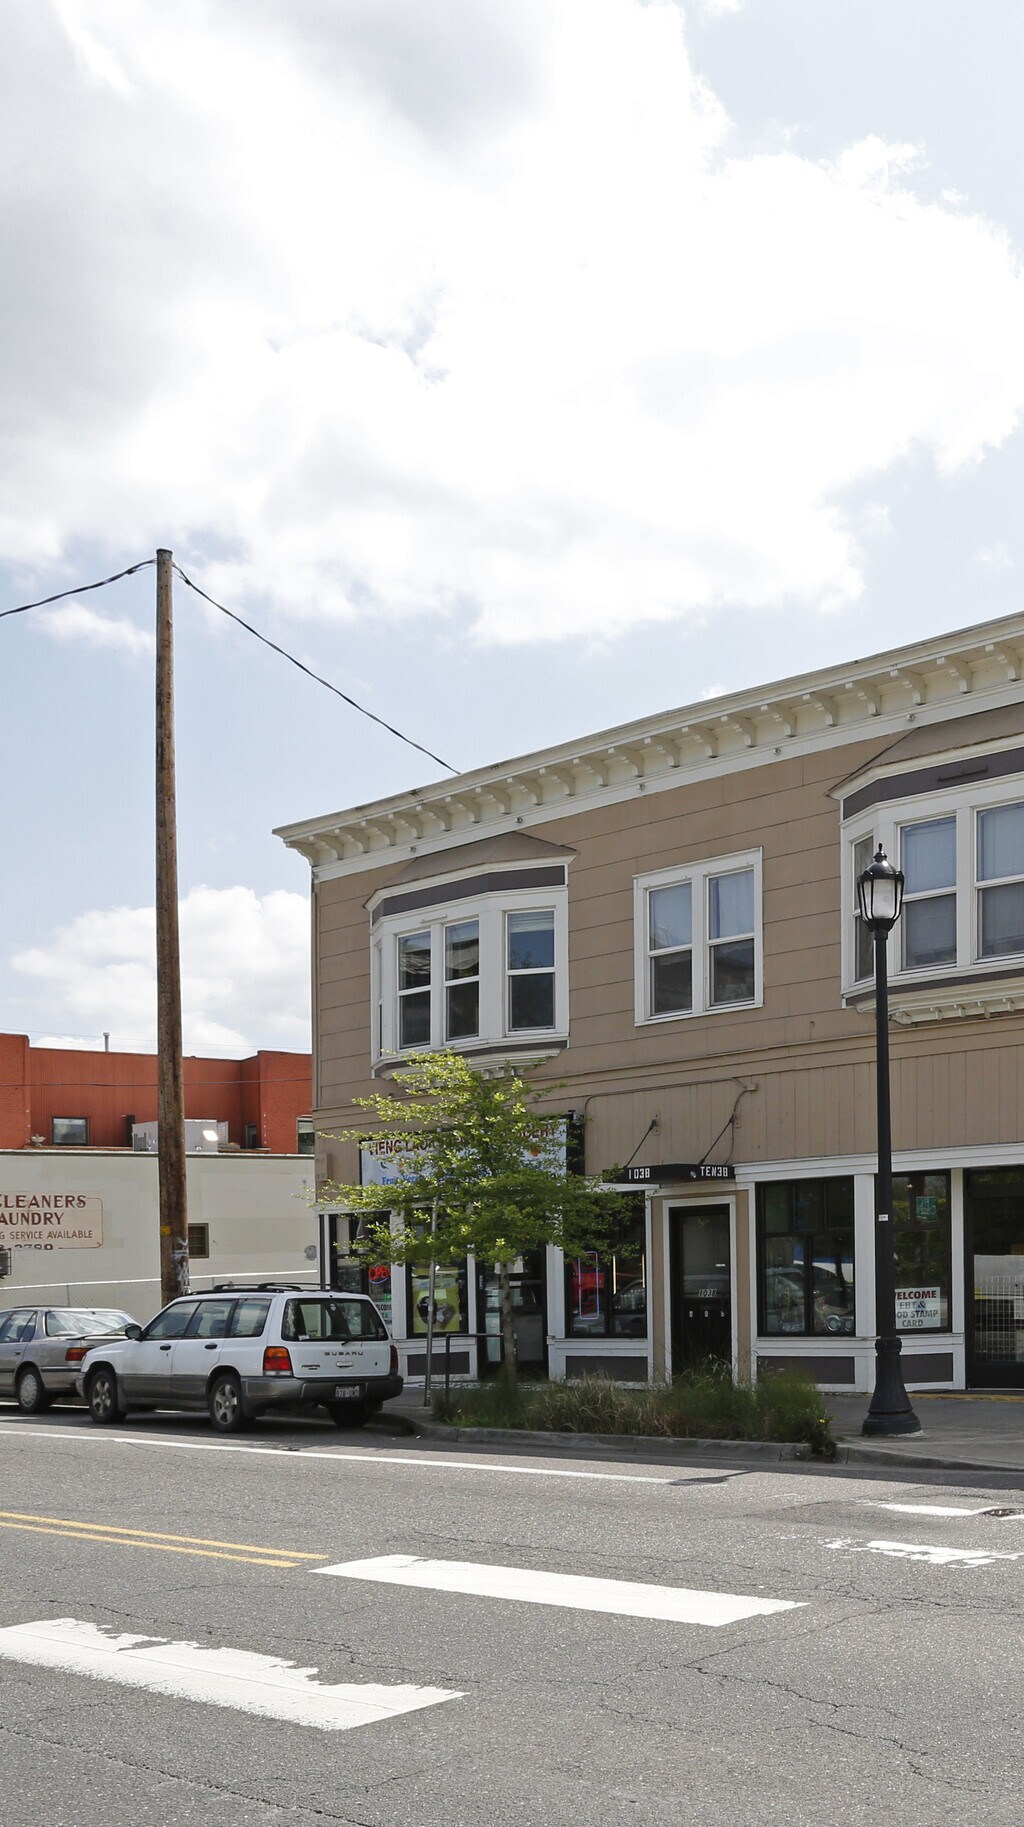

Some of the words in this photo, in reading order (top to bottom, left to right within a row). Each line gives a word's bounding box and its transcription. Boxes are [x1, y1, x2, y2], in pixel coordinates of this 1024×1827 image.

[628, 1168, 650, 1179] 1038
[700, 1166, 728, 1177] TEN38
[10, 1231, 43, 1240] SERVICE
[47, 1230, 93, 1239] AVAILABLE
[895, 1290, 937, 1300] ELCOME
[900, 1301, 916, 1309] EBT
[918, 1300, 926, 1309] &
[896, 1311, 908, 1319] OD
[910, 1309, 938, 1318] STAMP
[902, 1319, 923, 1327] CARD
